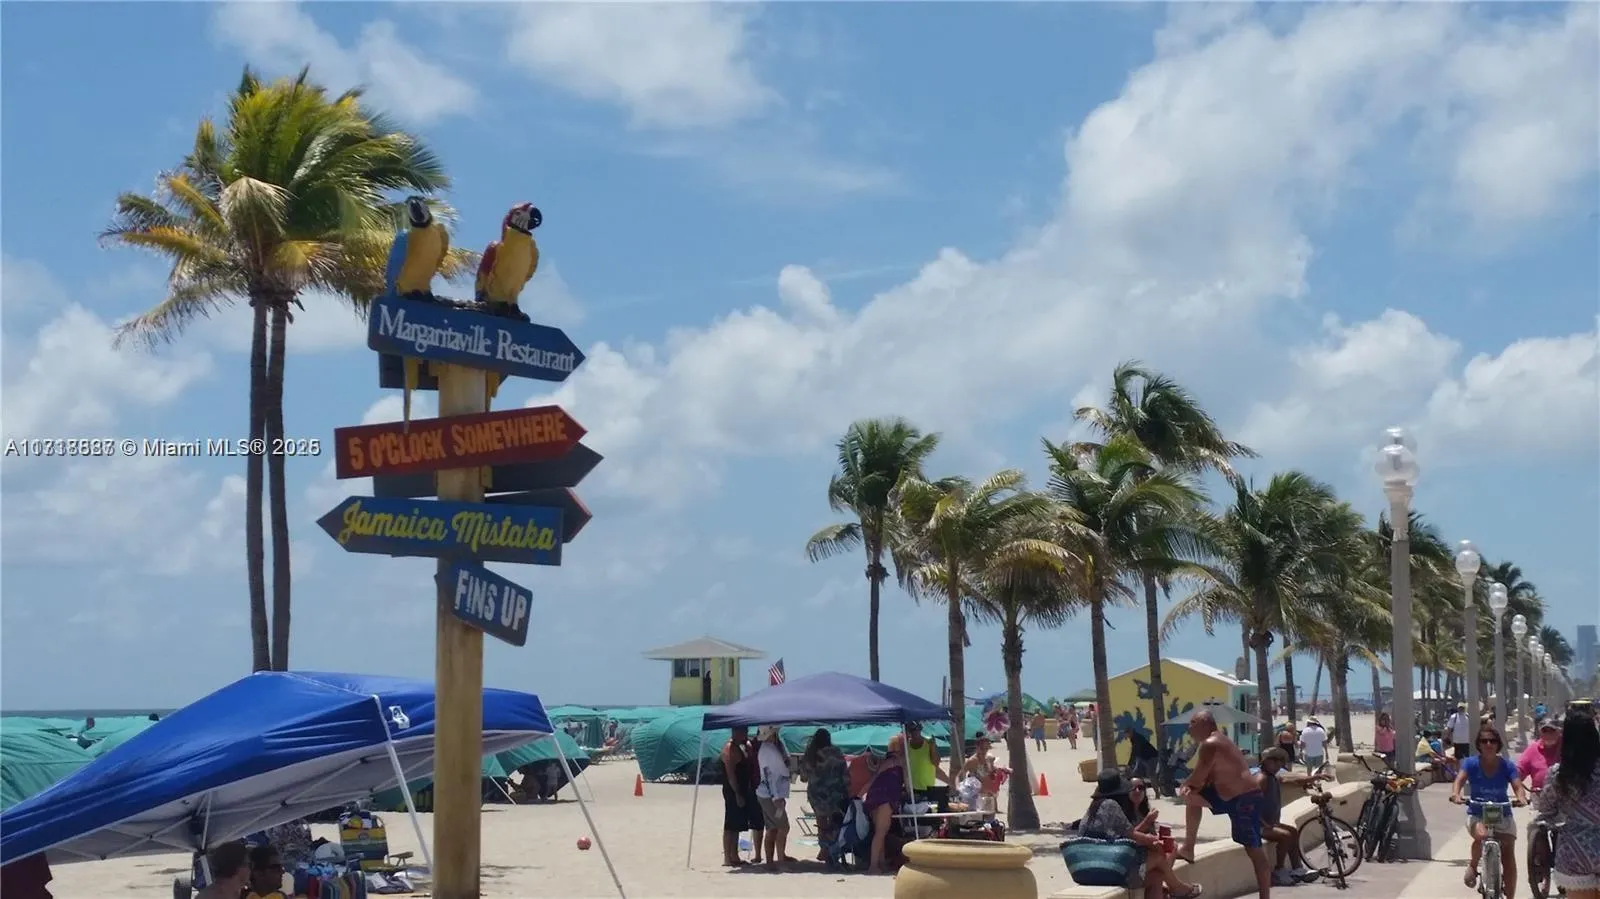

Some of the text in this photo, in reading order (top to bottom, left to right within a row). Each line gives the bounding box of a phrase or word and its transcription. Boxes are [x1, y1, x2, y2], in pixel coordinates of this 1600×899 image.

[377, 303, 575, 373] Margaritaville Restaurant
[348, 412, 568, 471] 5 O'CLOCK SOMEWHERE
[337, 500, 556, 553] Jamaica Mistaka
[454, 569, 528, 632] FINS UP
